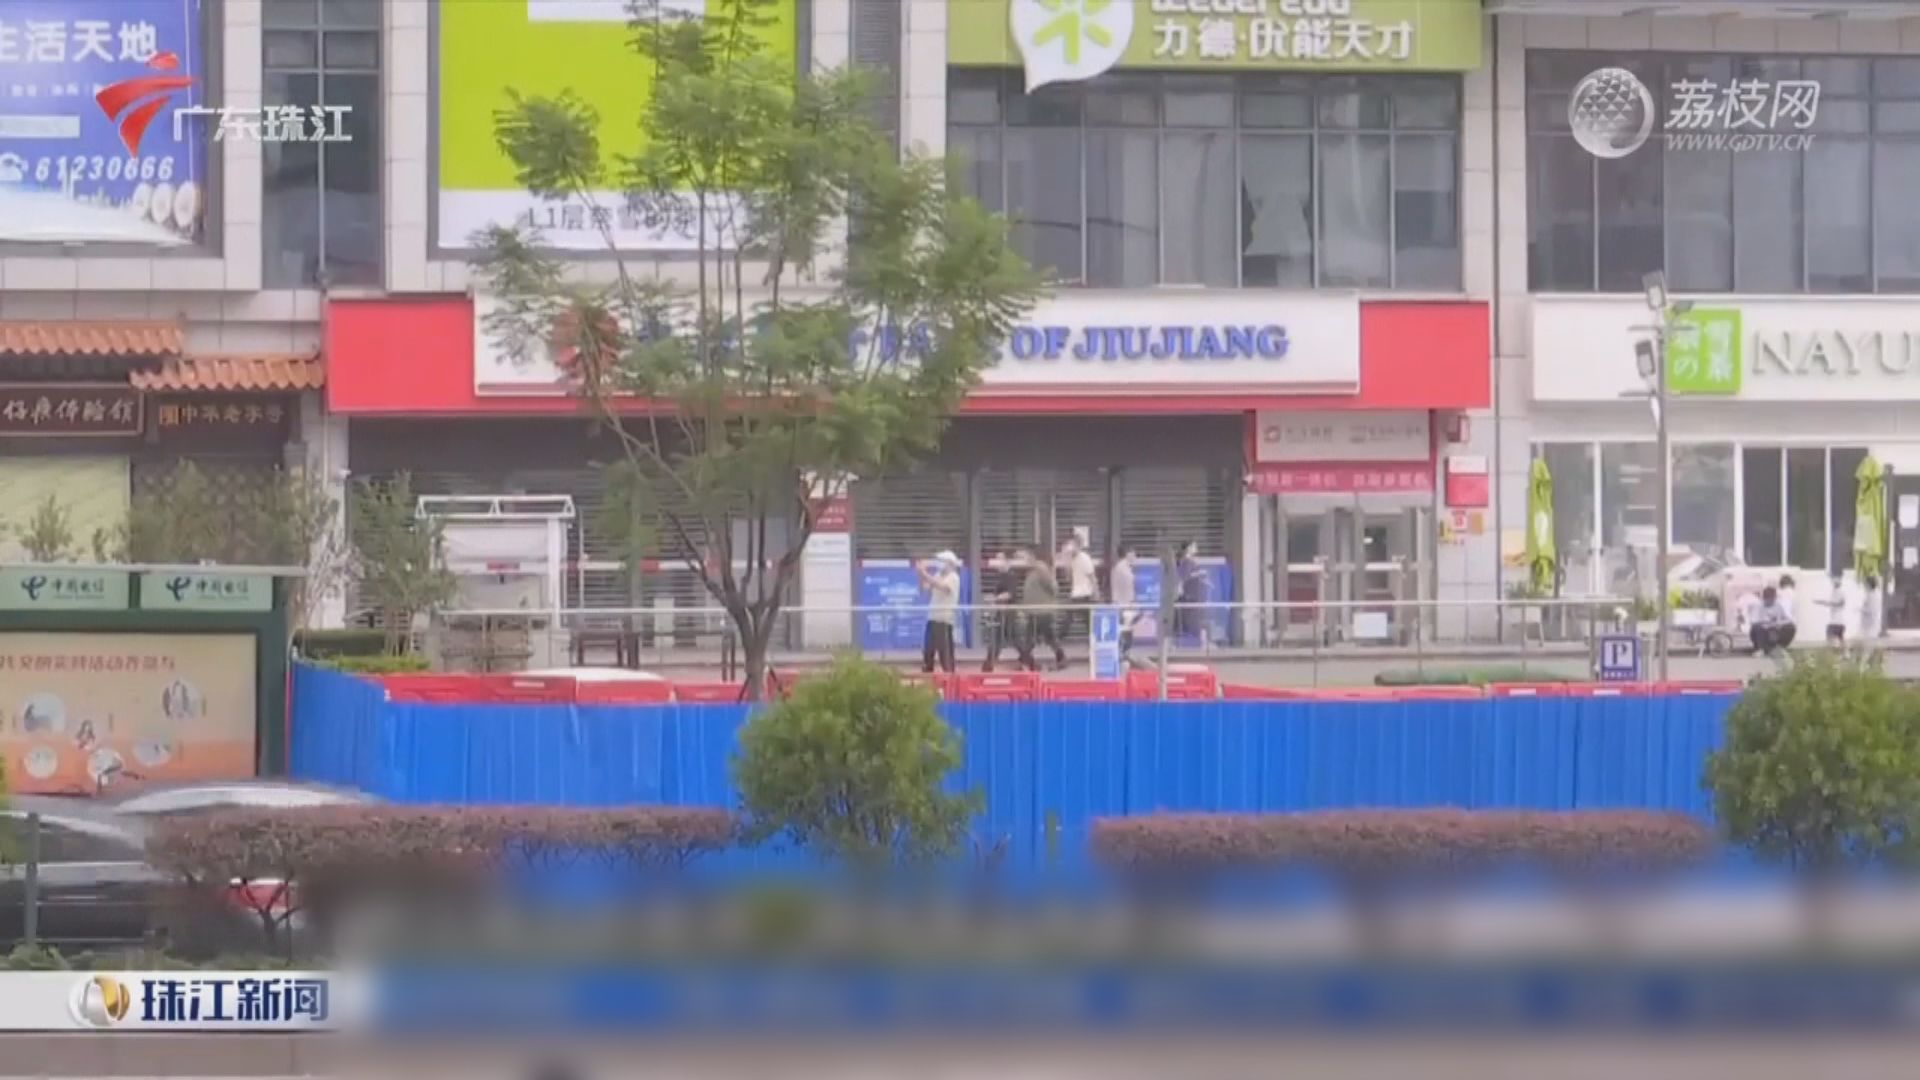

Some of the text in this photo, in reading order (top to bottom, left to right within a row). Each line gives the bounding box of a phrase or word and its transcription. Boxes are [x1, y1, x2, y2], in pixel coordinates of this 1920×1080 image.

[35, 155, 175, 182] 61230666
[1010, 326, 1070, 361] OF
[1072, 325, 1290, 361] JIUJIANG
[1611, 643, 1628, 666] P
